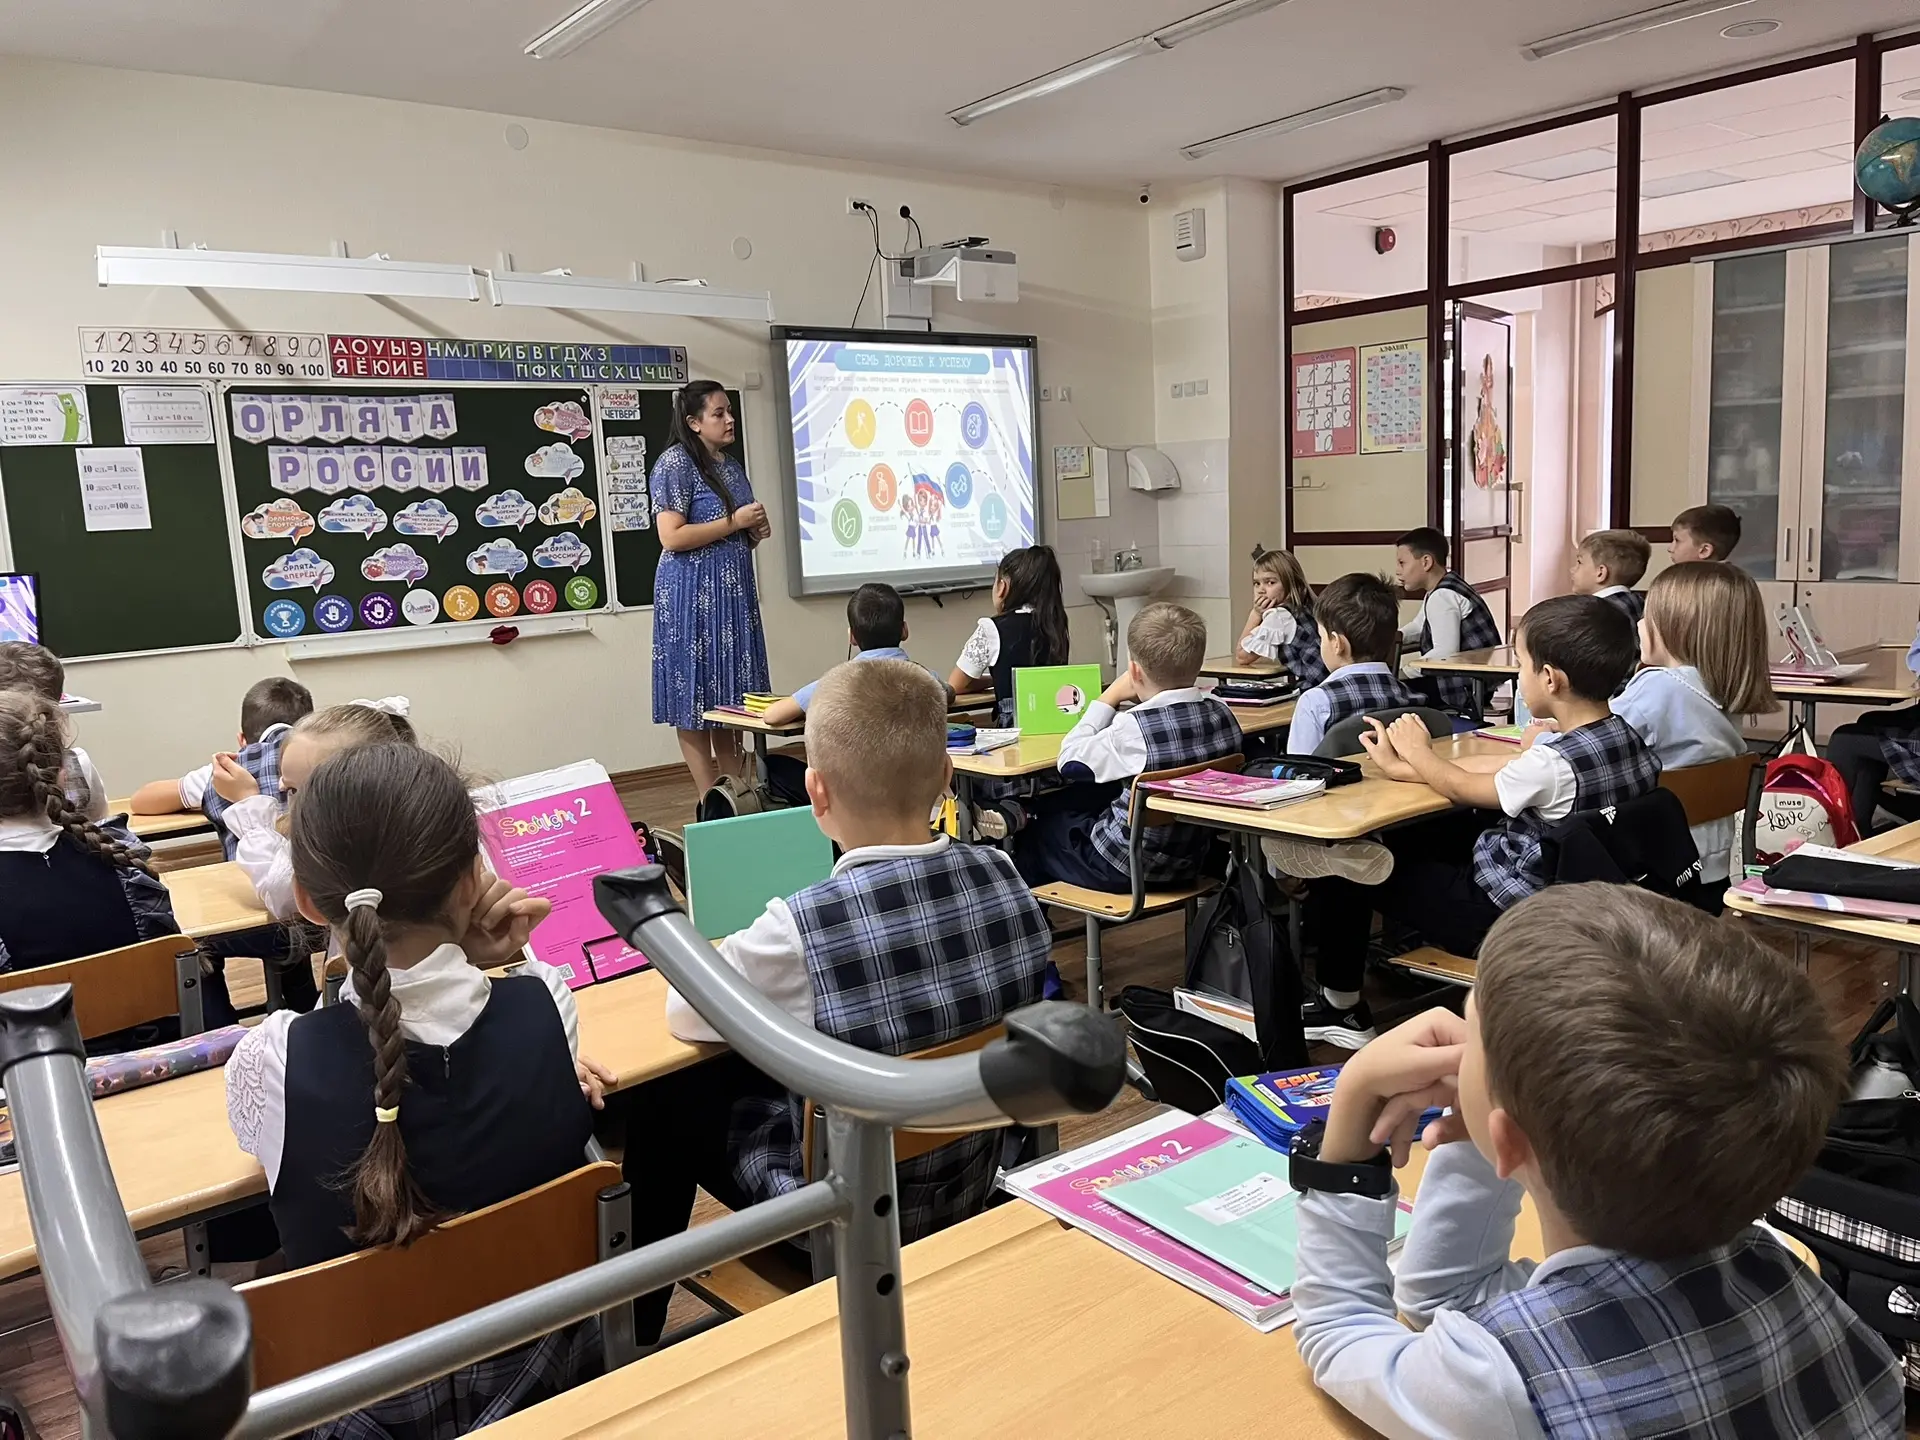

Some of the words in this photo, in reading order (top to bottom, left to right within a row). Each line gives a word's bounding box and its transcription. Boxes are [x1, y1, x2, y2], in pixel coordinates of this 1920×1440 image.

[95, 332, 105, 353] 1
[118, 332, 133, 354] 2
[142, 332, 158, 354] 3
[168, 332, 183, 355] 4
[191, 333, 206, 355] 5
[215, 334, 231, 356] 6
[238, 335, 253, 357] 7
[263, 335, 277, 357] 8
[288, 336, 300, 357] 9
[308, 337, 322, 358] 0
[86, 360, 104, 373] 10
[111, 360, 129, 373] 20
[136, 360, 154, 373] 30
[160, 361, 178, 374] 40
[184, 361, 202, 374] 50
[208, 362, 226, 375] 60
[232, 362, 249, 375] 70
[255, 363, 272, 375] 80
[277, 363, 294, 376] 90
[300, 364, 324, 376] 100
[855, 353, 880, 367] СЕМЬ
[884, 355, 924, 368] ДОРОЖЕК
[929, 357, 936, 368] К
[939, 357, 972, 369] УСПЕХУ
[1308, 369, 1314, 386] 1
[1324, 367, 1333, 384] 2
[1343, 364, 1351, 382] 3
[1307, 391, 1314, 408] 4
[1324, 390, 1332, 407] 5
[1342, 387, 1351, 405] 6
[241, 404, 451, 433] ОРЛЯТА
[605, 409, 637, 419] ЧЕТВЕРГ
[1307, 413, 1314, 430] 7
[1324, 412, 1332, 429] 8
[1343, 410, 1351, 427] 9
[83, 465, 93, 473] 10
[278, 455, 481, 485] РОССИИ
[86, 484, 95, 492] 10
[283, 563, 317, 572] ОРЛЯТА,
[499, 809, 578, 838] Spotlight
[574, 798, 592, 817] 2
[1161, 1139, 1193, 1155] 2
